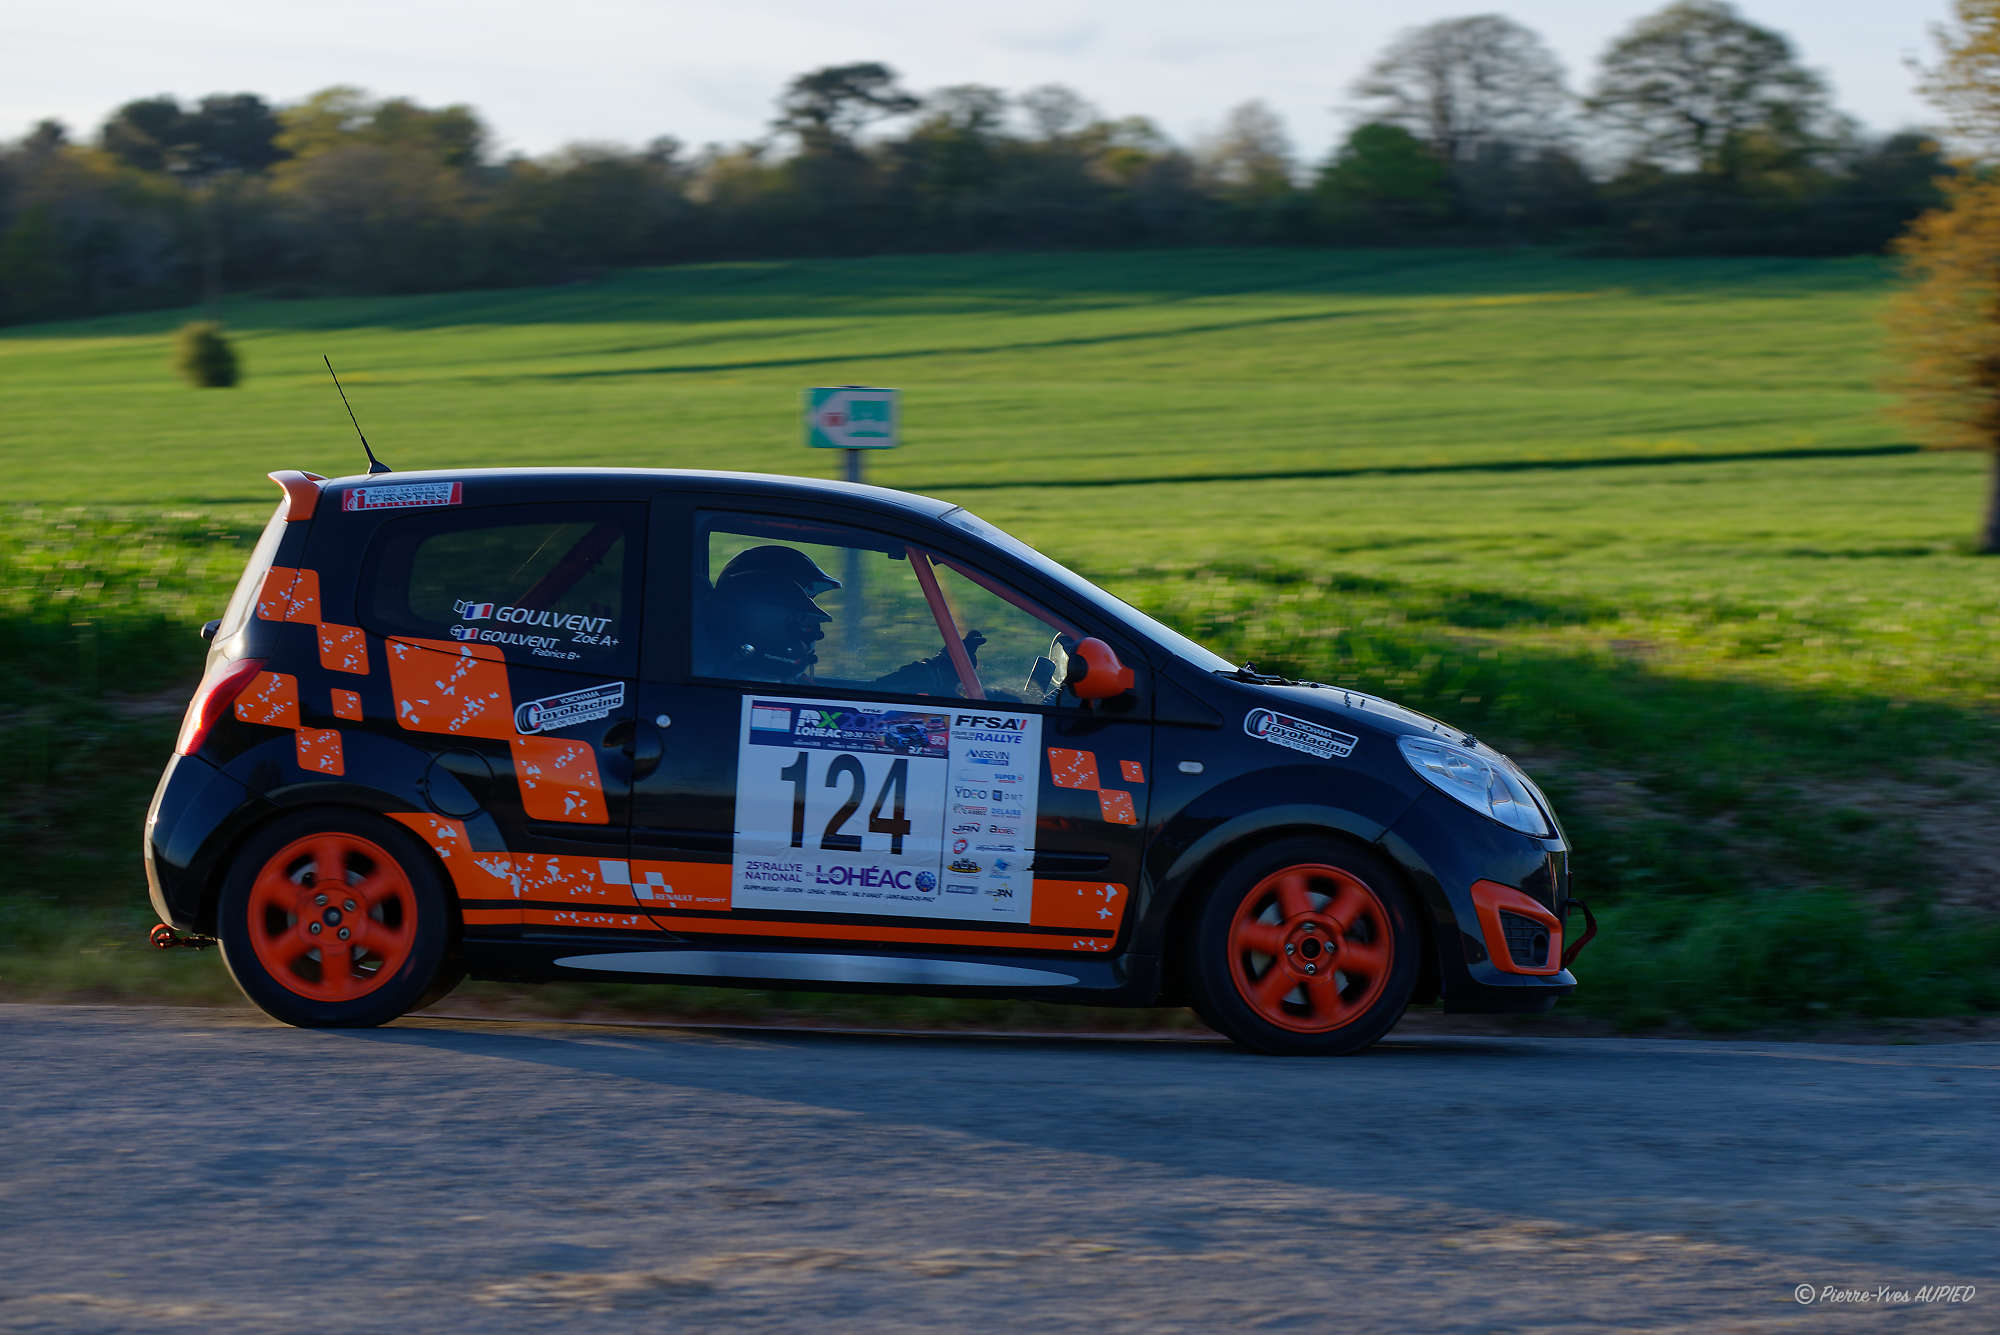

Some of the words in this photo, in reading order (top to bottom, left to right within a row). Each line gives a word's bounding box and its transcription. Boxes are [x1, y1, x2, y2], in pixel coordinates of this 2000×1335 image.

[495, 605, 613, 634] GOULVENT
[479, 629, 561, 650] GOULVENT
[571, 631, 600, 646] Zoé
[599, 634, 620, 647] A+
[532, 647, 566, 660] Fabrice
[567, 651, 582, 661] B+
[955, 714, 1019, 731] FFSA
[794, 726, 842, 739] LOHEAC
[974, 732, 1024, 745] RALLYE
[1264, 721, 1350, 756] ToyoRacing
[966, 749, 1010, 760] ANGEVIN
[780, 751, 912, 856] 124
[760, 861, 803, 873] RALLYE
[744, 871, 803, 884] NATIONAL
[815, 865, 913, 890] LOHÉAC
[655, 893, 693, 902] RENAULT
